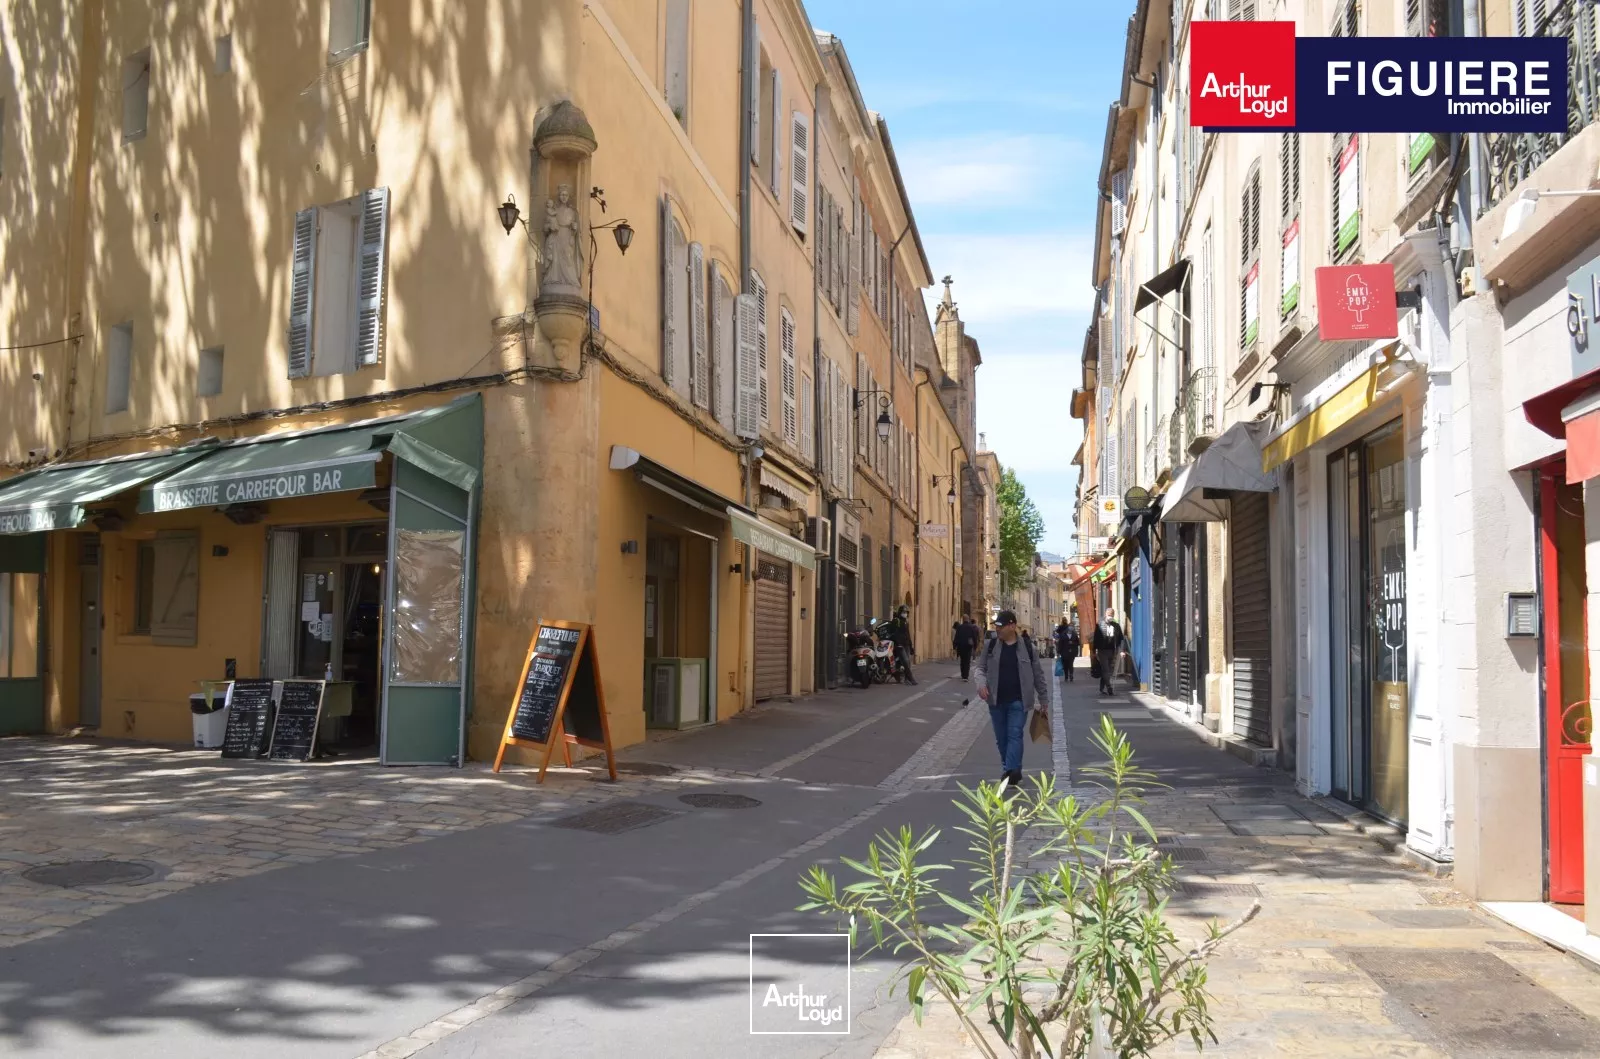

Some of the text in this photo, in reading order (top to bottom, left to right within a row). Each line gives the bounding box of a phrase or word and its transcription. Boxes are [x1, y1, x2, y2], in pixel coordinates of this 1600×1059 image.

[1346, 286, 1369, 297] EMKI
[1348, 296, 1367, 306] POP
[159, 469, 341, 510] BRASSERIE CARREFOUR BAR
[35, 511, 57, 529] BAR
[1384, 571, 1404, 600] EMKI
[1386, 603, 1403, 631] POP
